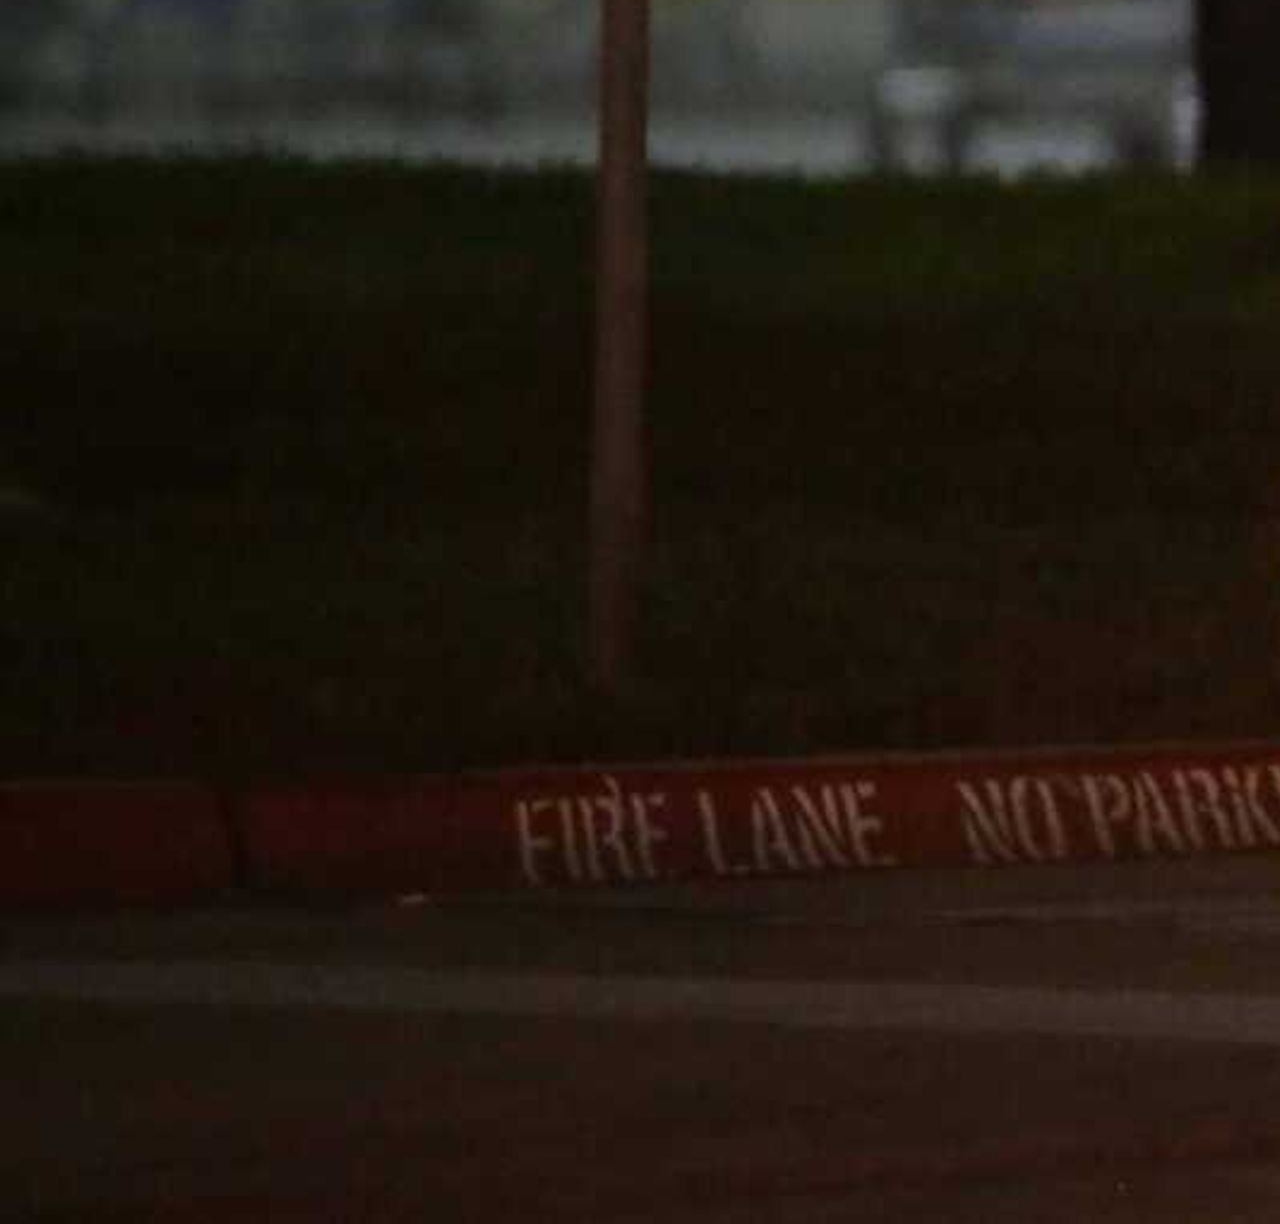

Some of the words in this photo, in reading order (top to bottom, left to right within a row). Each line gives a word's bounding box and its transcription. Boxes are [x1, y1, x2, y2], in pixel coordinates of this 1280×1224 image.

[514, 777, 668, 885] FIRE
[698, 780, 898, 875] LANE
[956, 775, 1067, 864] NO
